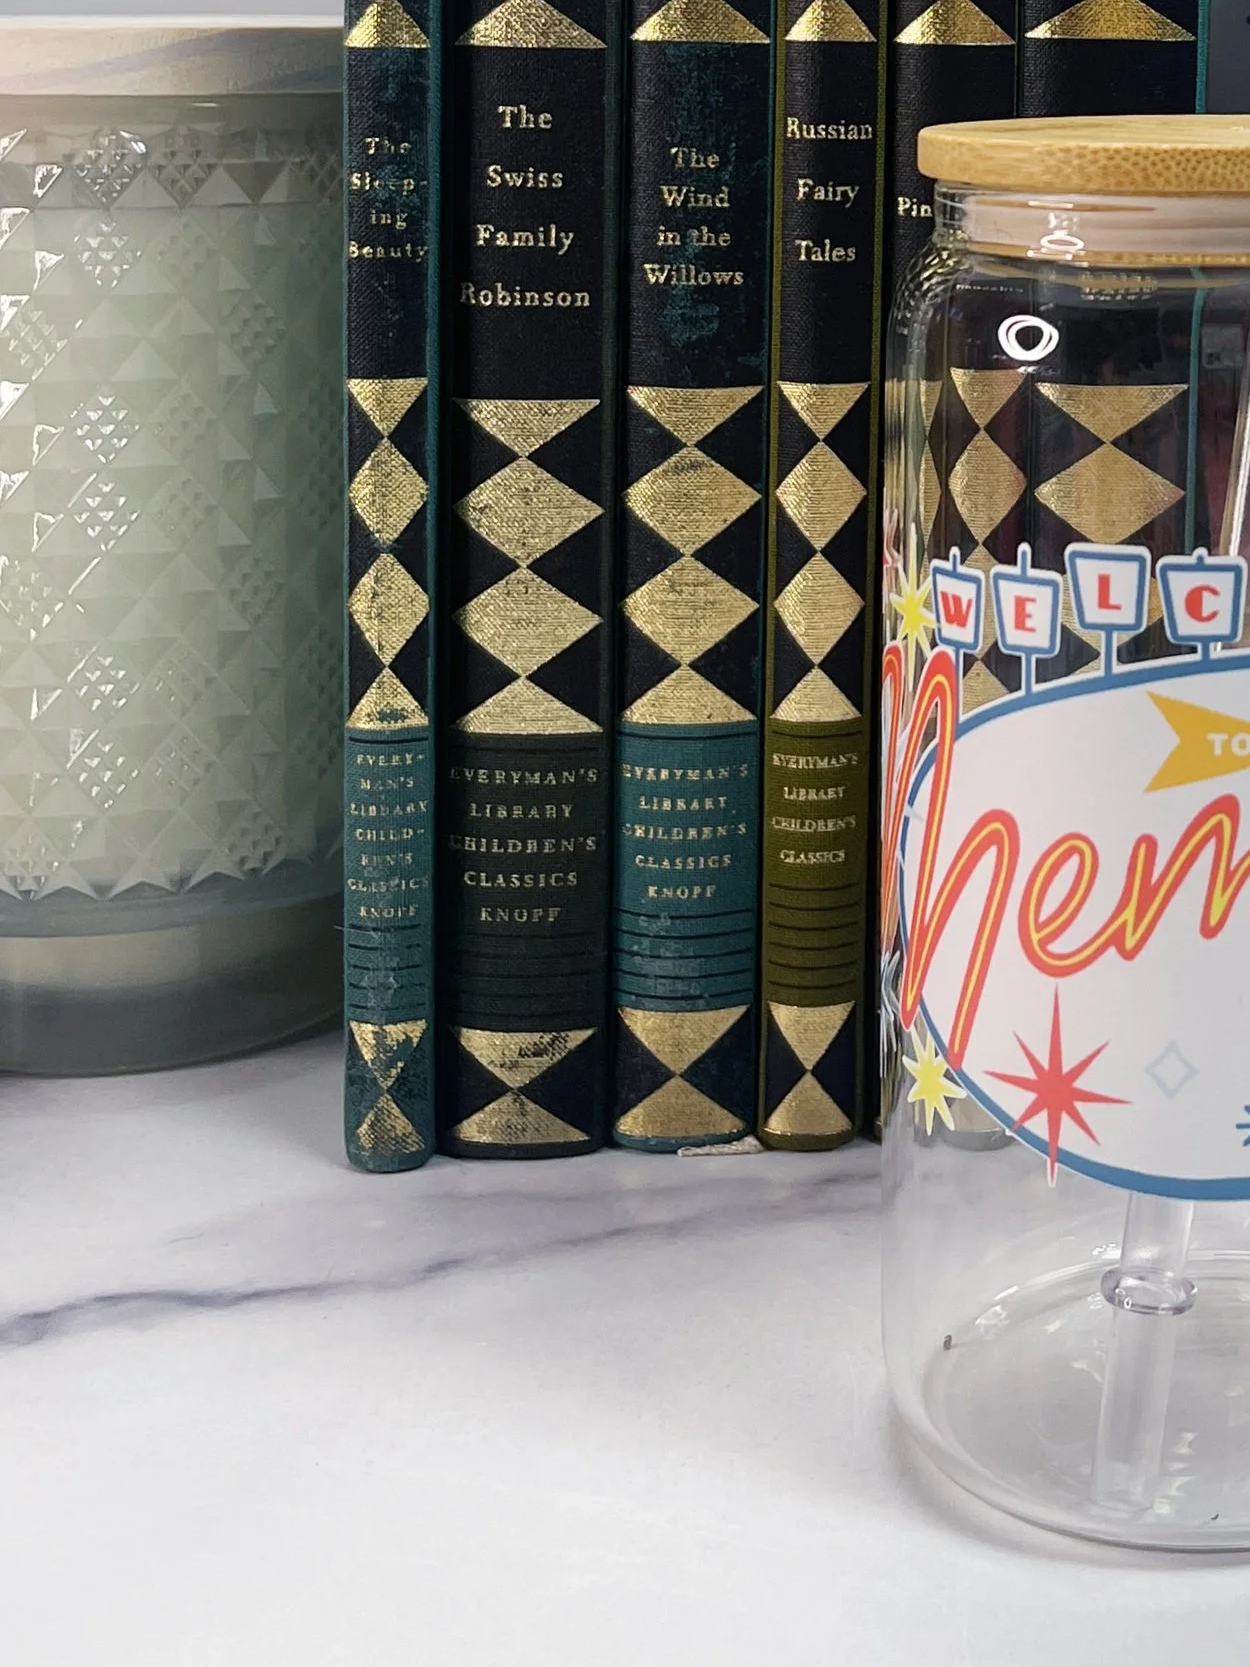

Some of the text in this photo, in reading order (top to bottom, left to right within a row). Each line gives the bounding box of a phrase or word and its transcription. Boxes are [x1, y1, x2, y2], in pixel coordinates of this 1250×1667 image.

[497, 104, 553, 130] The
[786, 116, 874, 141] Russian
[365, 137, 412, 155] The
[669, 145, 721, 169] The
[486, 164, 565, 189] Swiss
[659, 185, 731, 208] Wind
[796, 178, 860, 208] Fairy
[369, 209, 409, 230] ing
[475, 223, 575, 256] Family
[656, 225, 732, 248] in the
[348, 240, 429, 263] Beauty
[796, 238, 857, 263] Tales
[642, 262, 745, 286] Willows
[460, 282, 592, 308] Robinson
[450, 768, 598, 786] EVERYMAN'S
[622, 763, 749, 781] EVERYMAN'S
[639, 795, 728, 812] LIBRARY
[784, 786, 847, 802] LIBRARY
[469, 803, 574, 819] LIBRARY
[622, 822, 747, 840] CHILDREN'S
[450, 836, 598, 854] CHILDREN'S
[635, 854, 732, 870] CLASSICS
[779, 849, 846, 865] CLASSICS
[464, 871, 579, 888] CLASSICS
[648, 885, 717, 900] KNOPF
[479, 907, 561, 922] KNOPF
